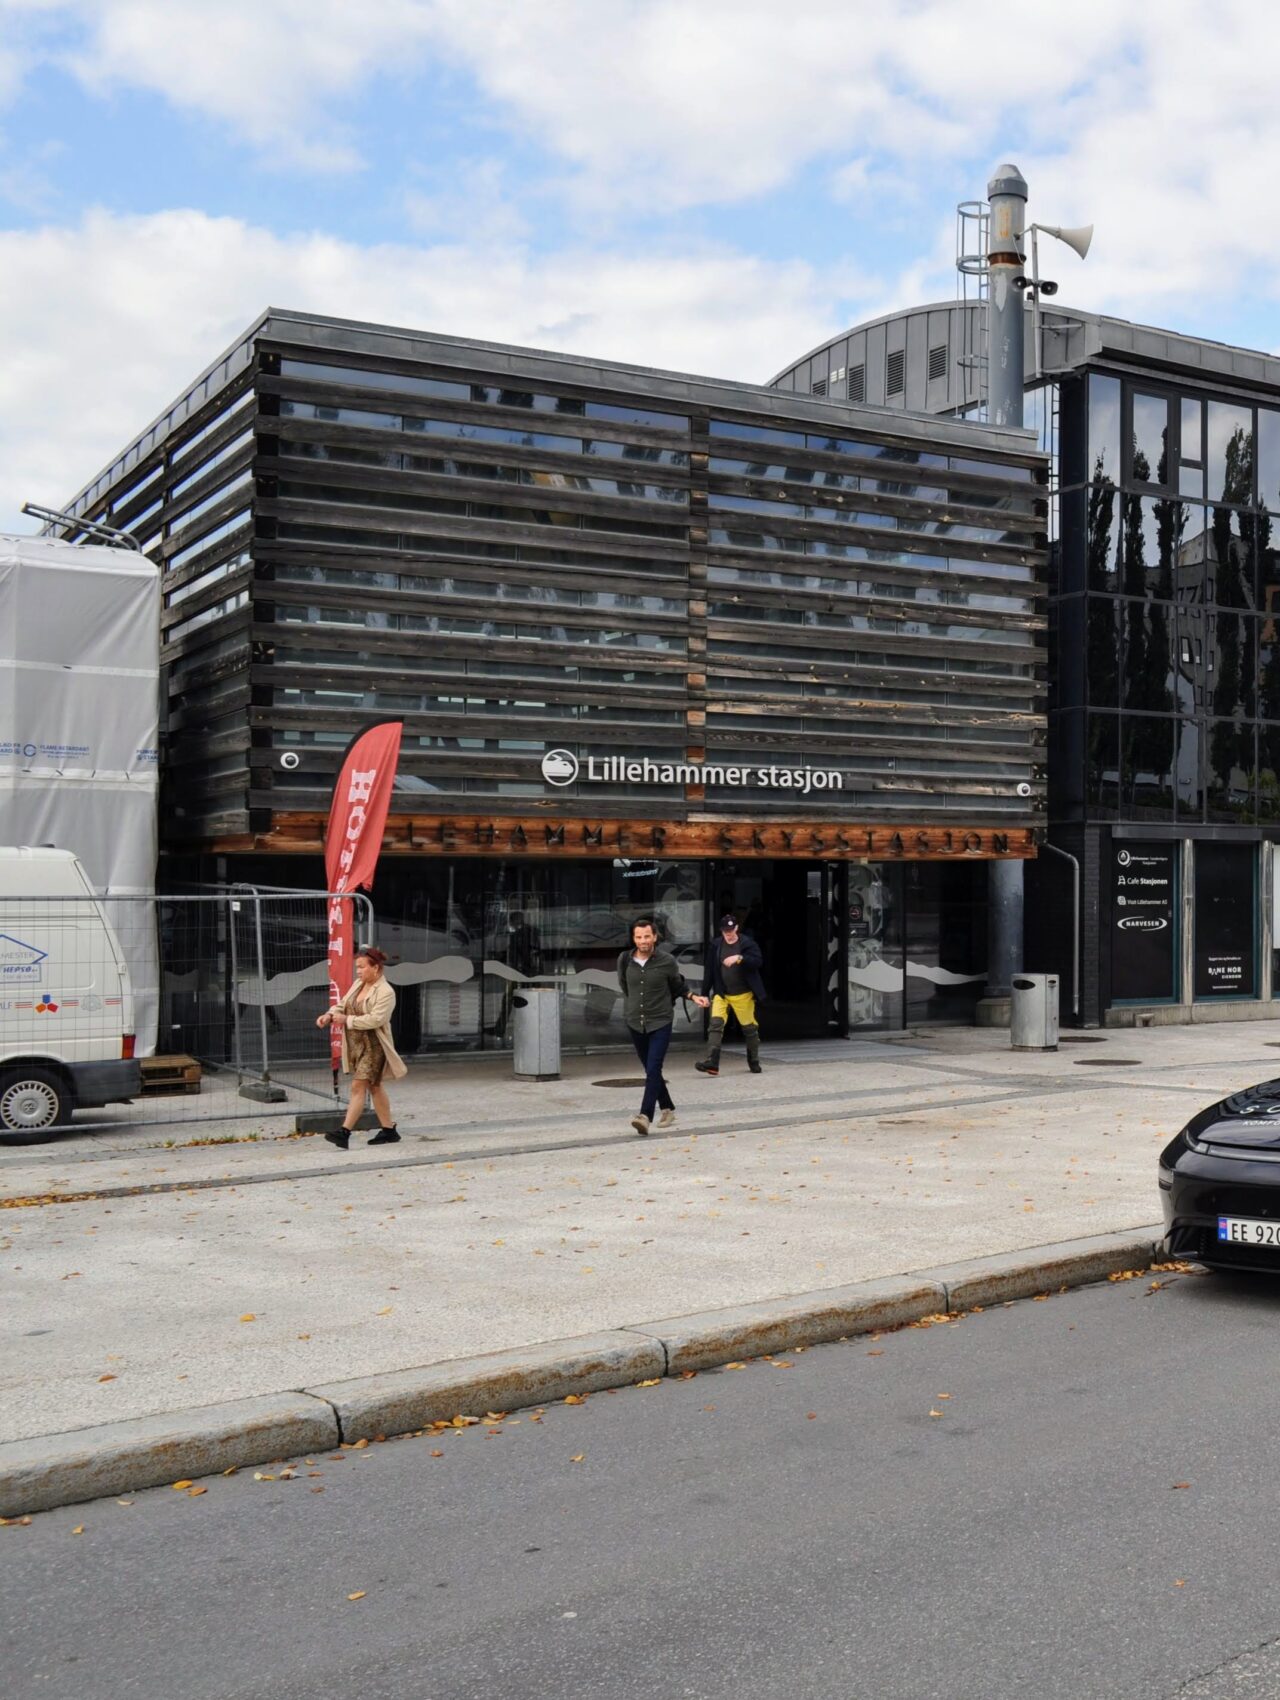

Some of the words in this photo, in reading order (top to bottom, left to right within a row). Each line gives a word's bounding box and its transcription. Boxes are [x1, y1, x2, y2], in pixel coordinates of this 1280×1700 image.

[588, 756, 751, 785] Lillehammer
[757, 766, 844, 794] stasjon
[1140, 877, 1168, 886] Stasjonen
[1208, 967, 1226, 976] BANE
[1227, 966, 1242, 974] NOR
[1231, 1223, 1248, 1242] EE
